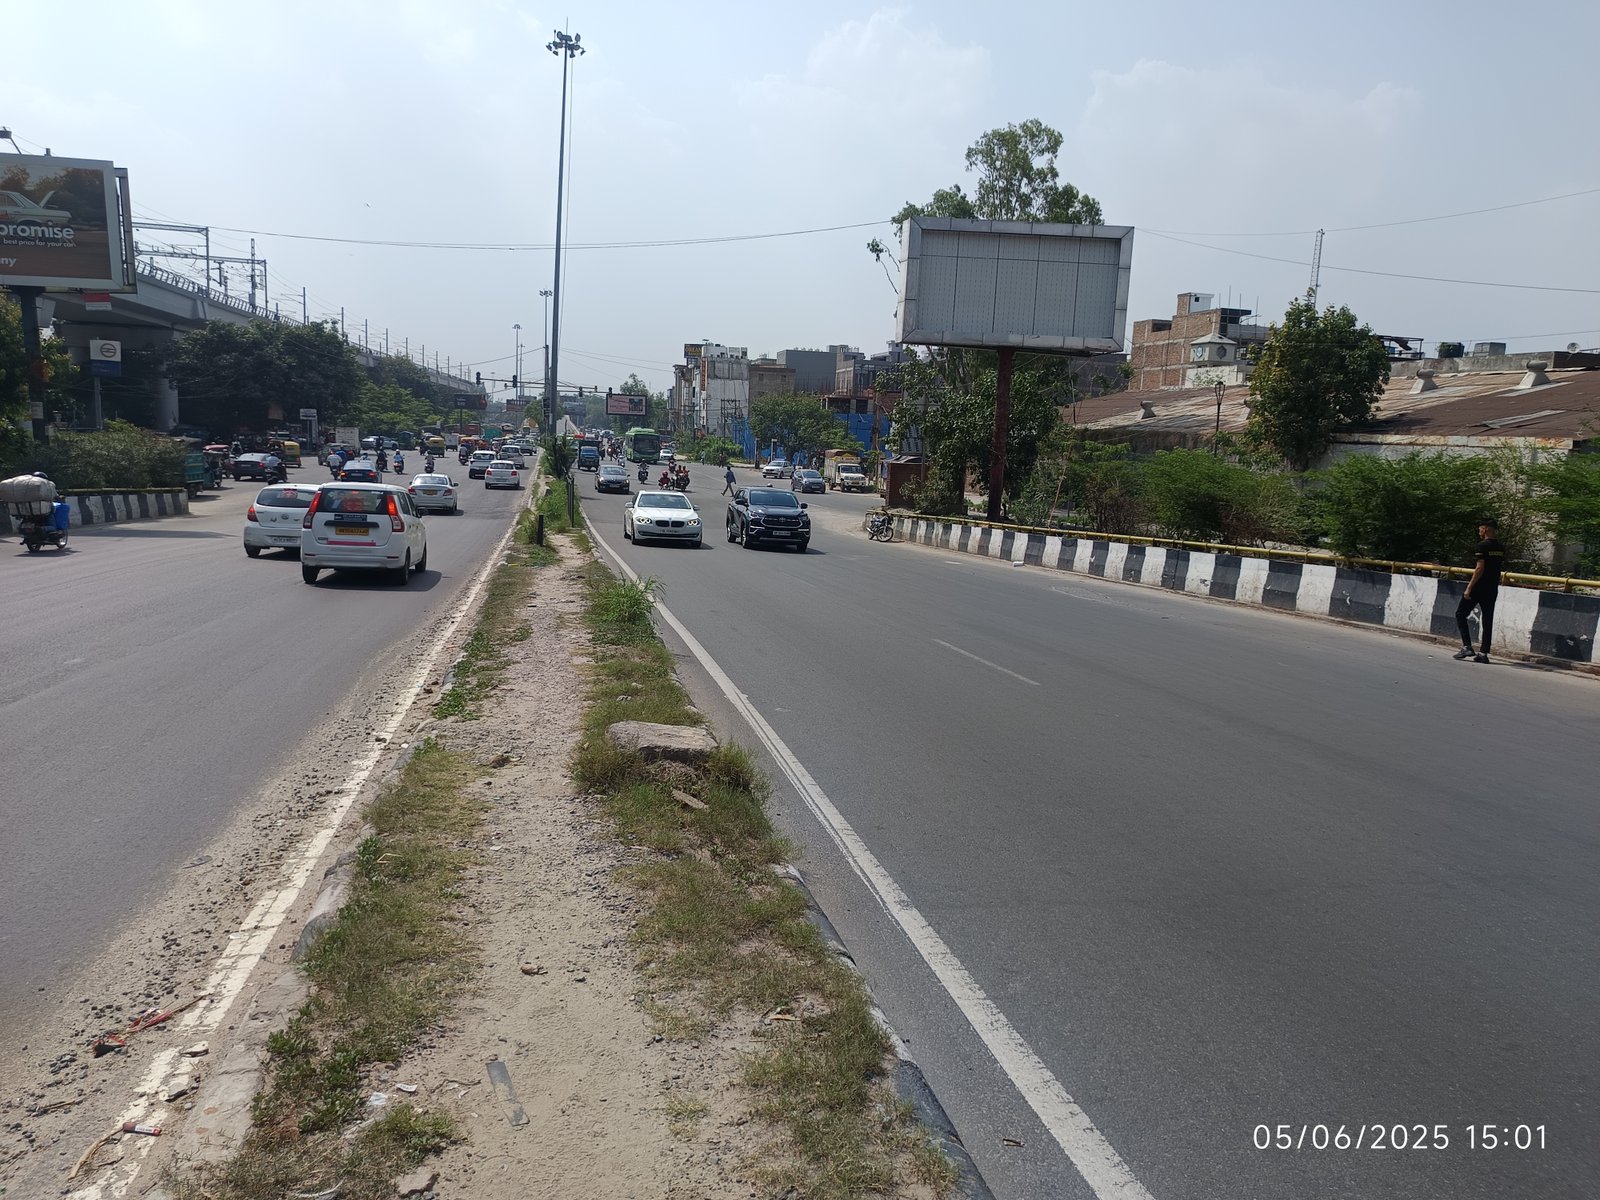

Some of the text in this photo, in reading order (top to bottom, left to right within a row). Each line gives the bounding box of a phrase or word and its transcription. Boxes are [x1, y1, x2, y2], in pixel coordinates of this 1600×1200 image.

[3, 237, 18, 246] best
[18, 239, 35, 247] price
[0, 256, 17, 267] ny
